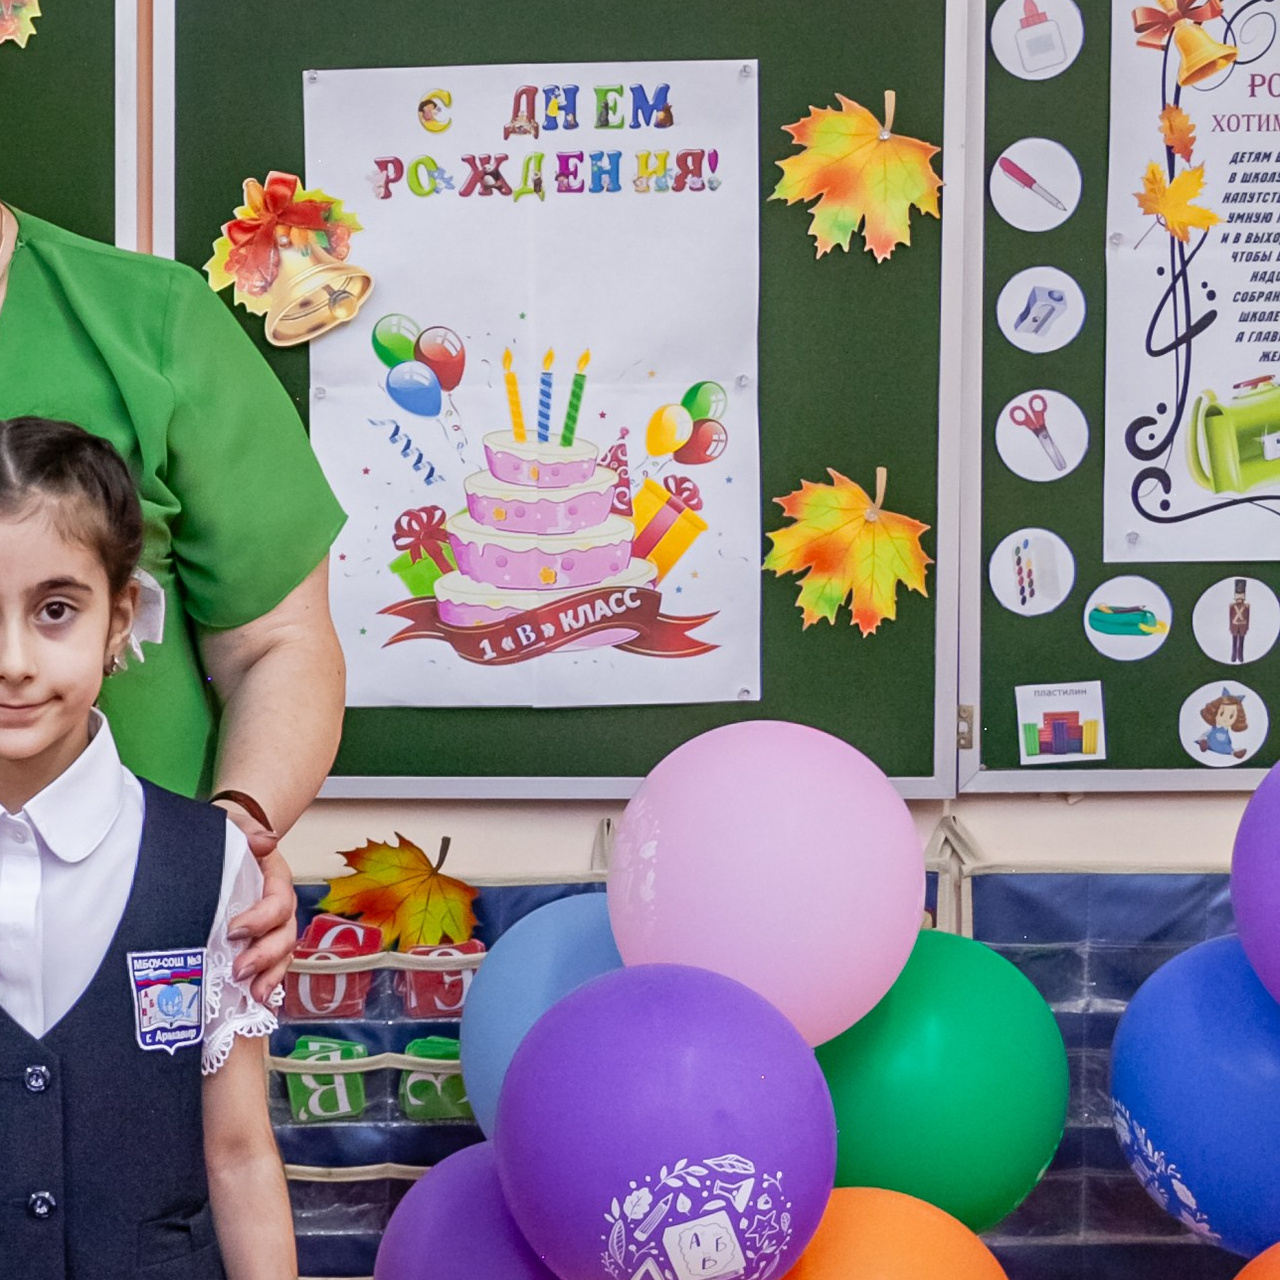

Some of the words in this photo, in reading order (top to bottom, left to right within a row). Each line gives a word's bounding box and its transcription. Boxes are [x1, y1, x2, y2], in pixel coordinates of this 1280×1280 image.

[417, 88, 453, 134] С
[503, 82, 675, 141] ДНЕМ
[1229, 152, 1272, 164] ДЕТЯМ
[368, 147, 721, 203] РОЖДЕНИЯ!
[1228, 172, 1238, 183] В
[1227, 212, 1273, 223] УМНУЮ
[1244, 232, 1280, 244] ВЫХО
[1231, 251, 1273, 262] ЧТОБЫ
[479, 638, 497, 660] 1
[558, 587, 641, 633] КЛАСС
[1033, 687, 1088, 698] пластилин
[134, 957, 184, 970] МБОУ-СОШ
[155, 1029, 197, 1043] Армавир
